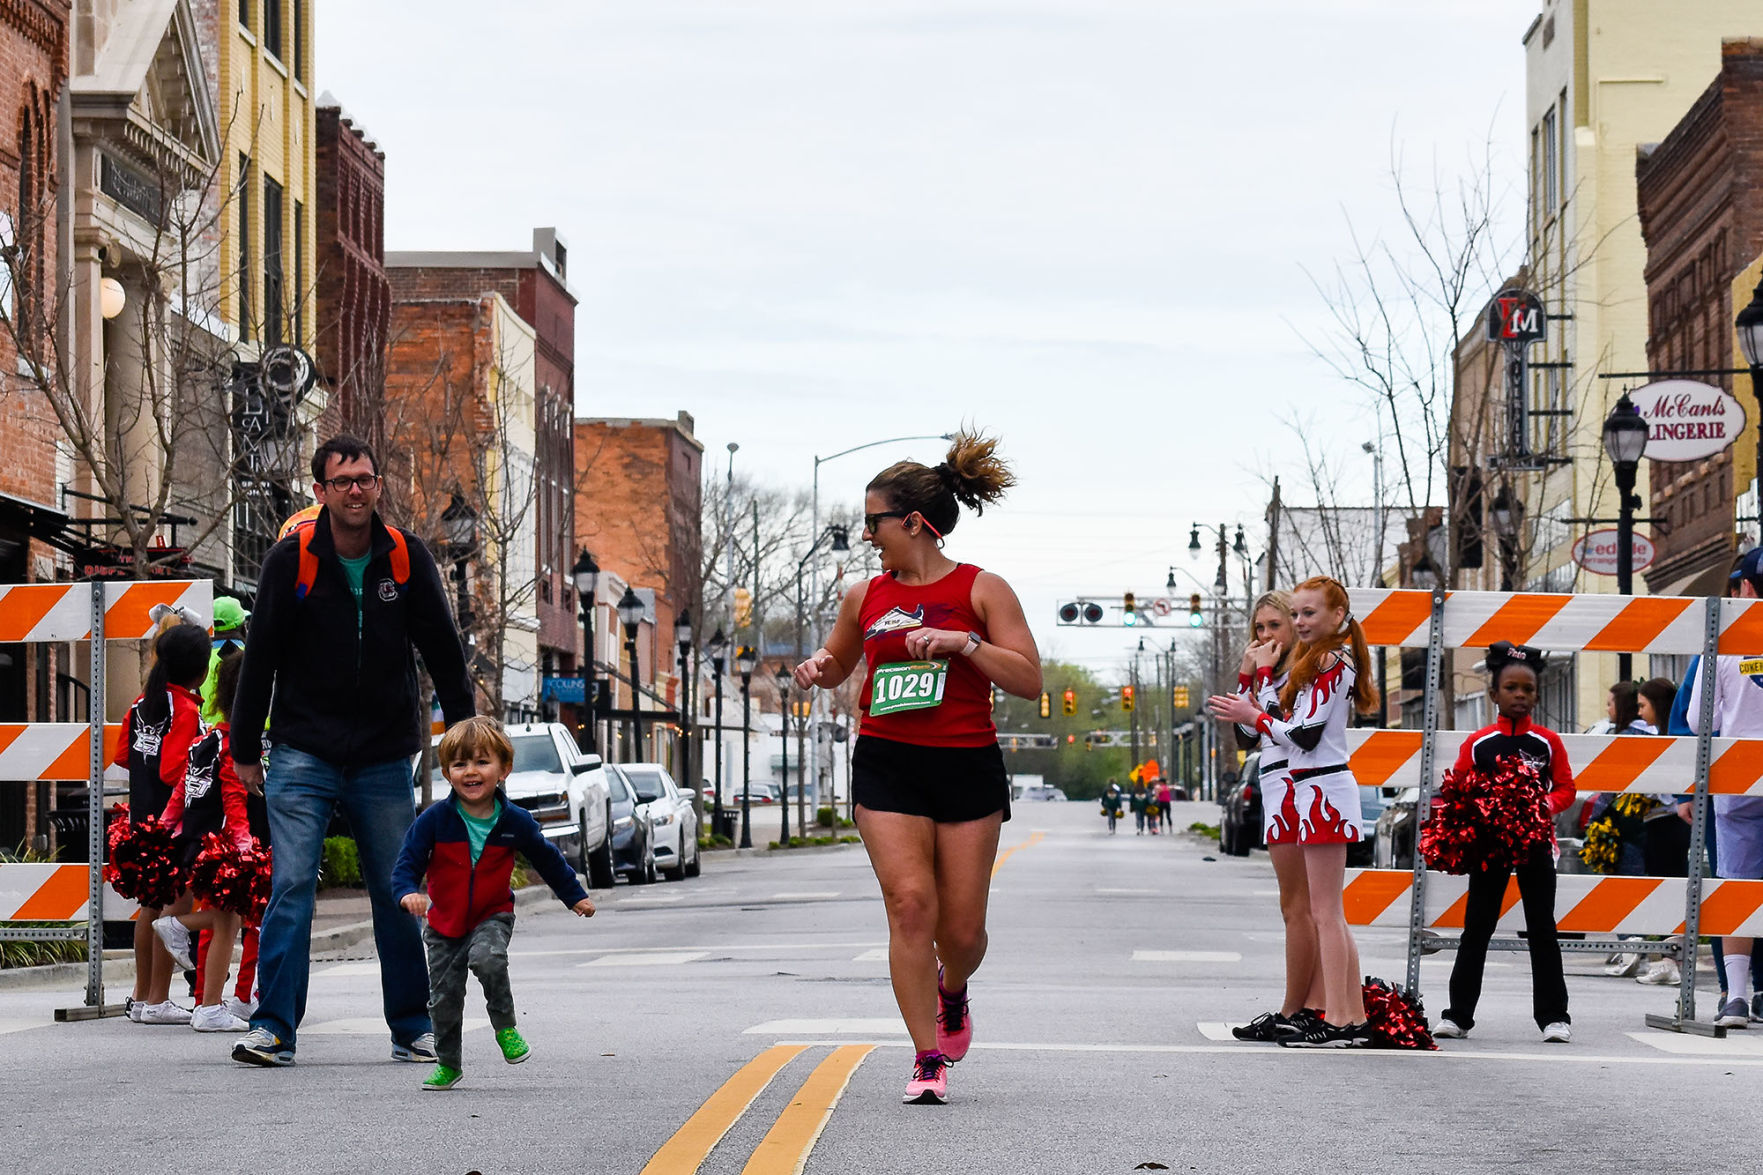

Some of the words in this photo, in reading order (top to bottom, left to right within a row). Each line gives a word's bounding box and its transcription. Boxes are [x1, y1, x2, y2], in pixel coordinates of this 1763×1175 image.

[1644, 394, 1726, 418] McCants
[1647, 422, 1726, 441] LINGERIE
[1595, 543, 1646, 555] edle
[875, 672, 934, 704] 1029
